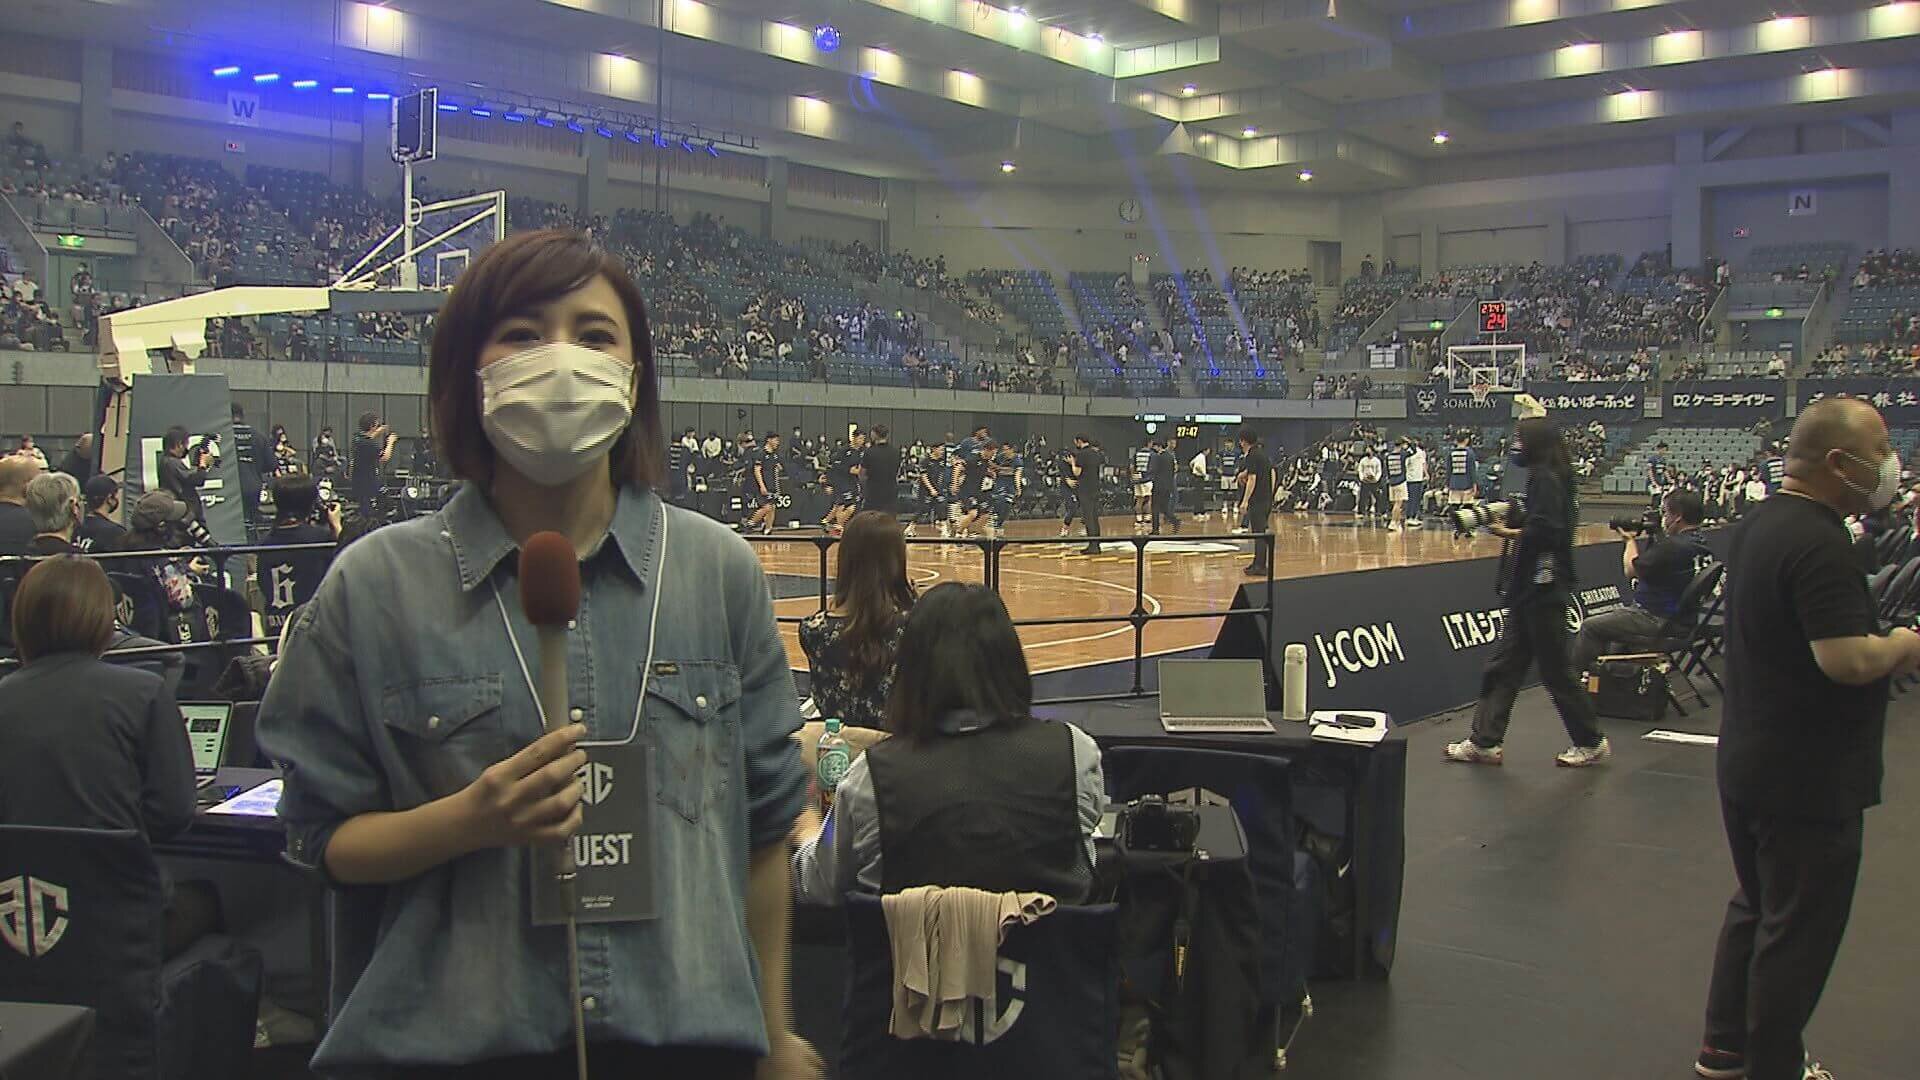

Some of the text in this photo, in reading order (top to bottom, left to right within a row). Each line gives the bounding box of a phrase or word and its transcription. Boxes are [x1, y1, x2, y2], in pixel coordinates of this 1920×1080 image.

[232, 98, 255, 119] W
[1794, 194, 1811, 209] N
[1487, 313, 1505, 329] 24
[1442, 398, 1497, 409] SOMEDAY
[1673, 394, 1690, 407] D2
[1177, 426, 1199, 437] 27:47
[1315, 622, 1405, 688] J:COM
[574, 833, 632, 866] UEST
